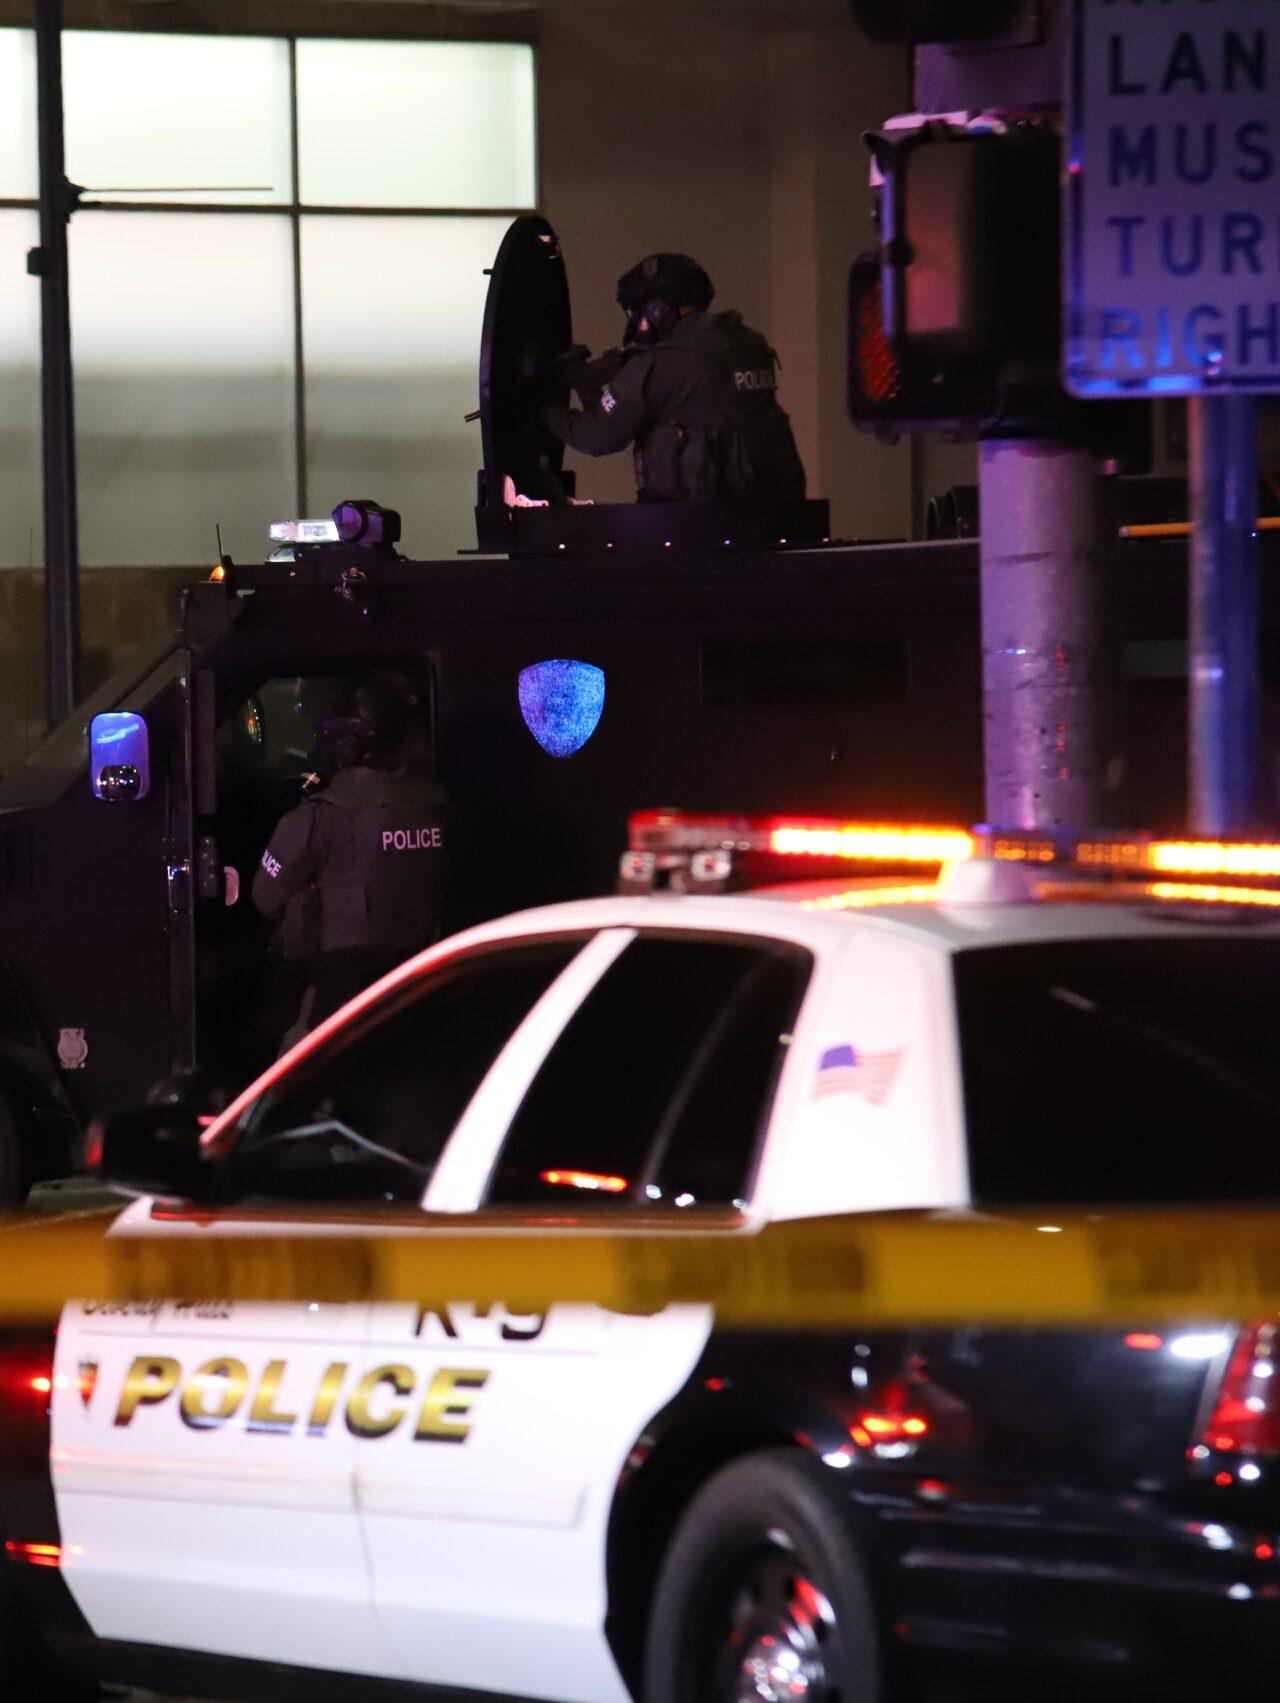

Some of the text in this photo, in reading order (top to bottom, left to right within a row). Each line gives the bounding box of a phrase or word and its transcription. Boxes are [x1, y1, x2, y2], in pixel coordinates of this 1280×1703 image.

[1110, 30, 1266, 95] LAN
[1110, 122, 1275, 186] MUS
[1106, 212, 1280, 278] TUR
[1099, 304, 1280, 370] RIGH
[382, 828, 442, 850] POLICE
[112, 1355, 491, 1444] POLICE
